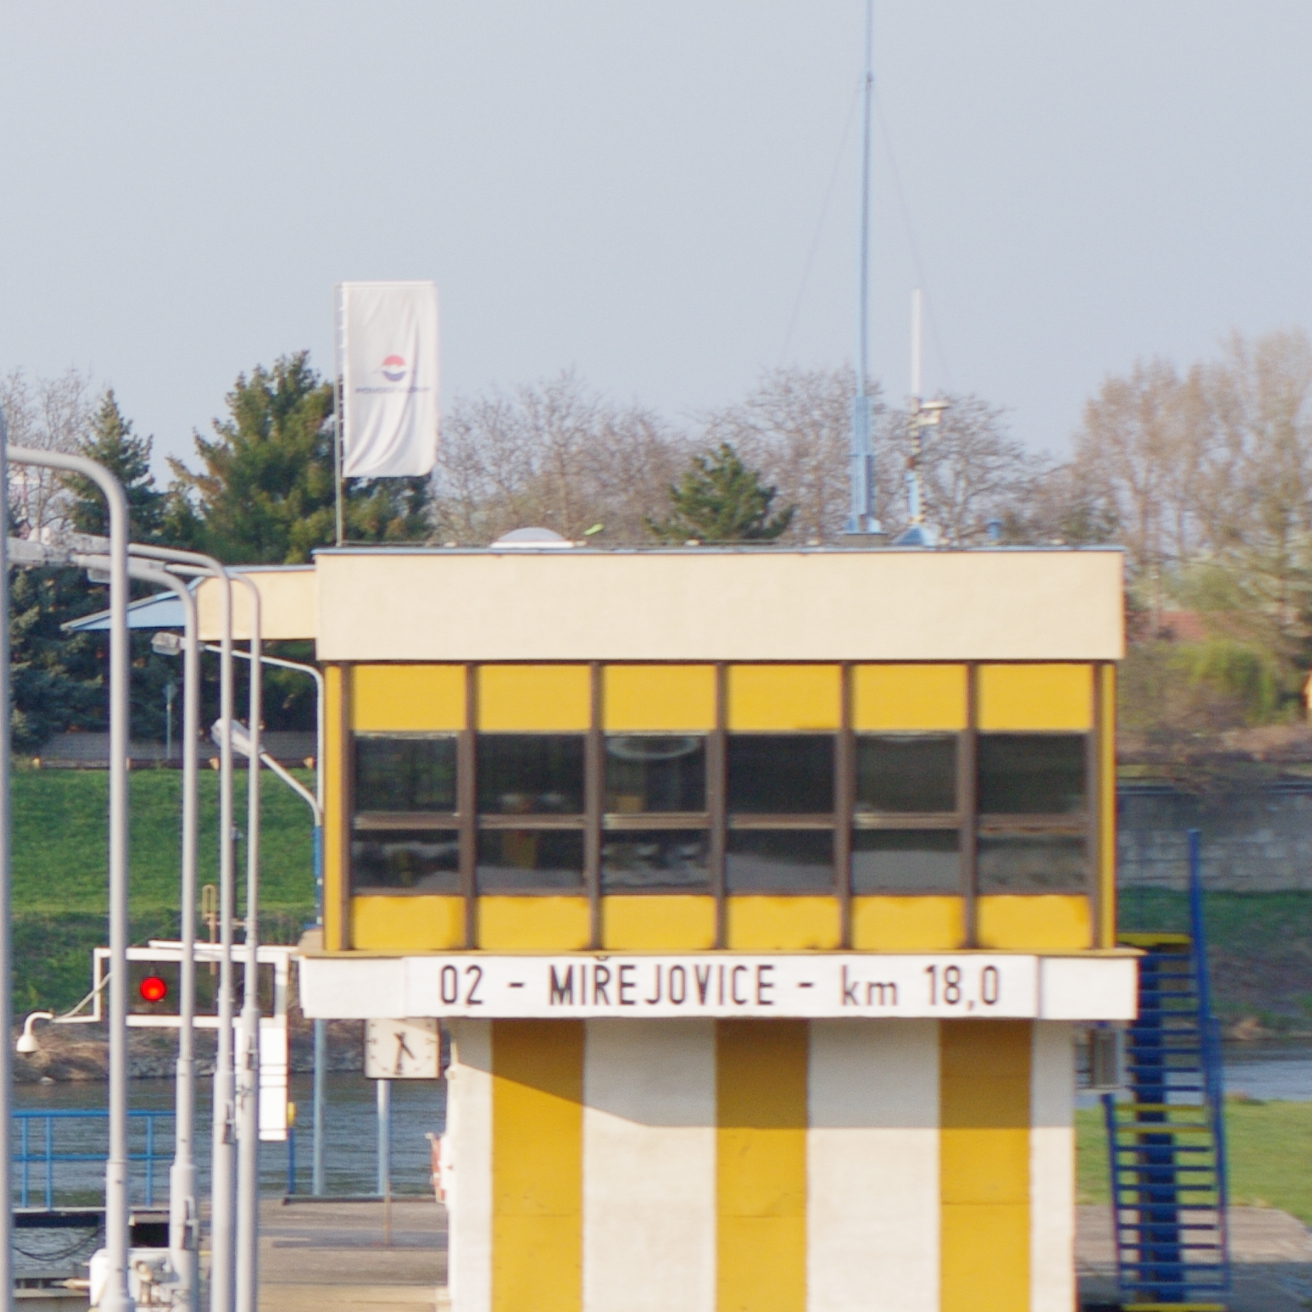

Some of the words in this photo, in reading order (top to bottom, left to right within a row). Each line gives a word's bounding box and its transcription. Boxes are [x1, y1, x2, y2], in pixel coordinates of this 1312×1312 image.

[439, 964, 484, 1006] 02
[840, 964, 898, 1006] km
[923, 964, 999, 1011] 18,0
